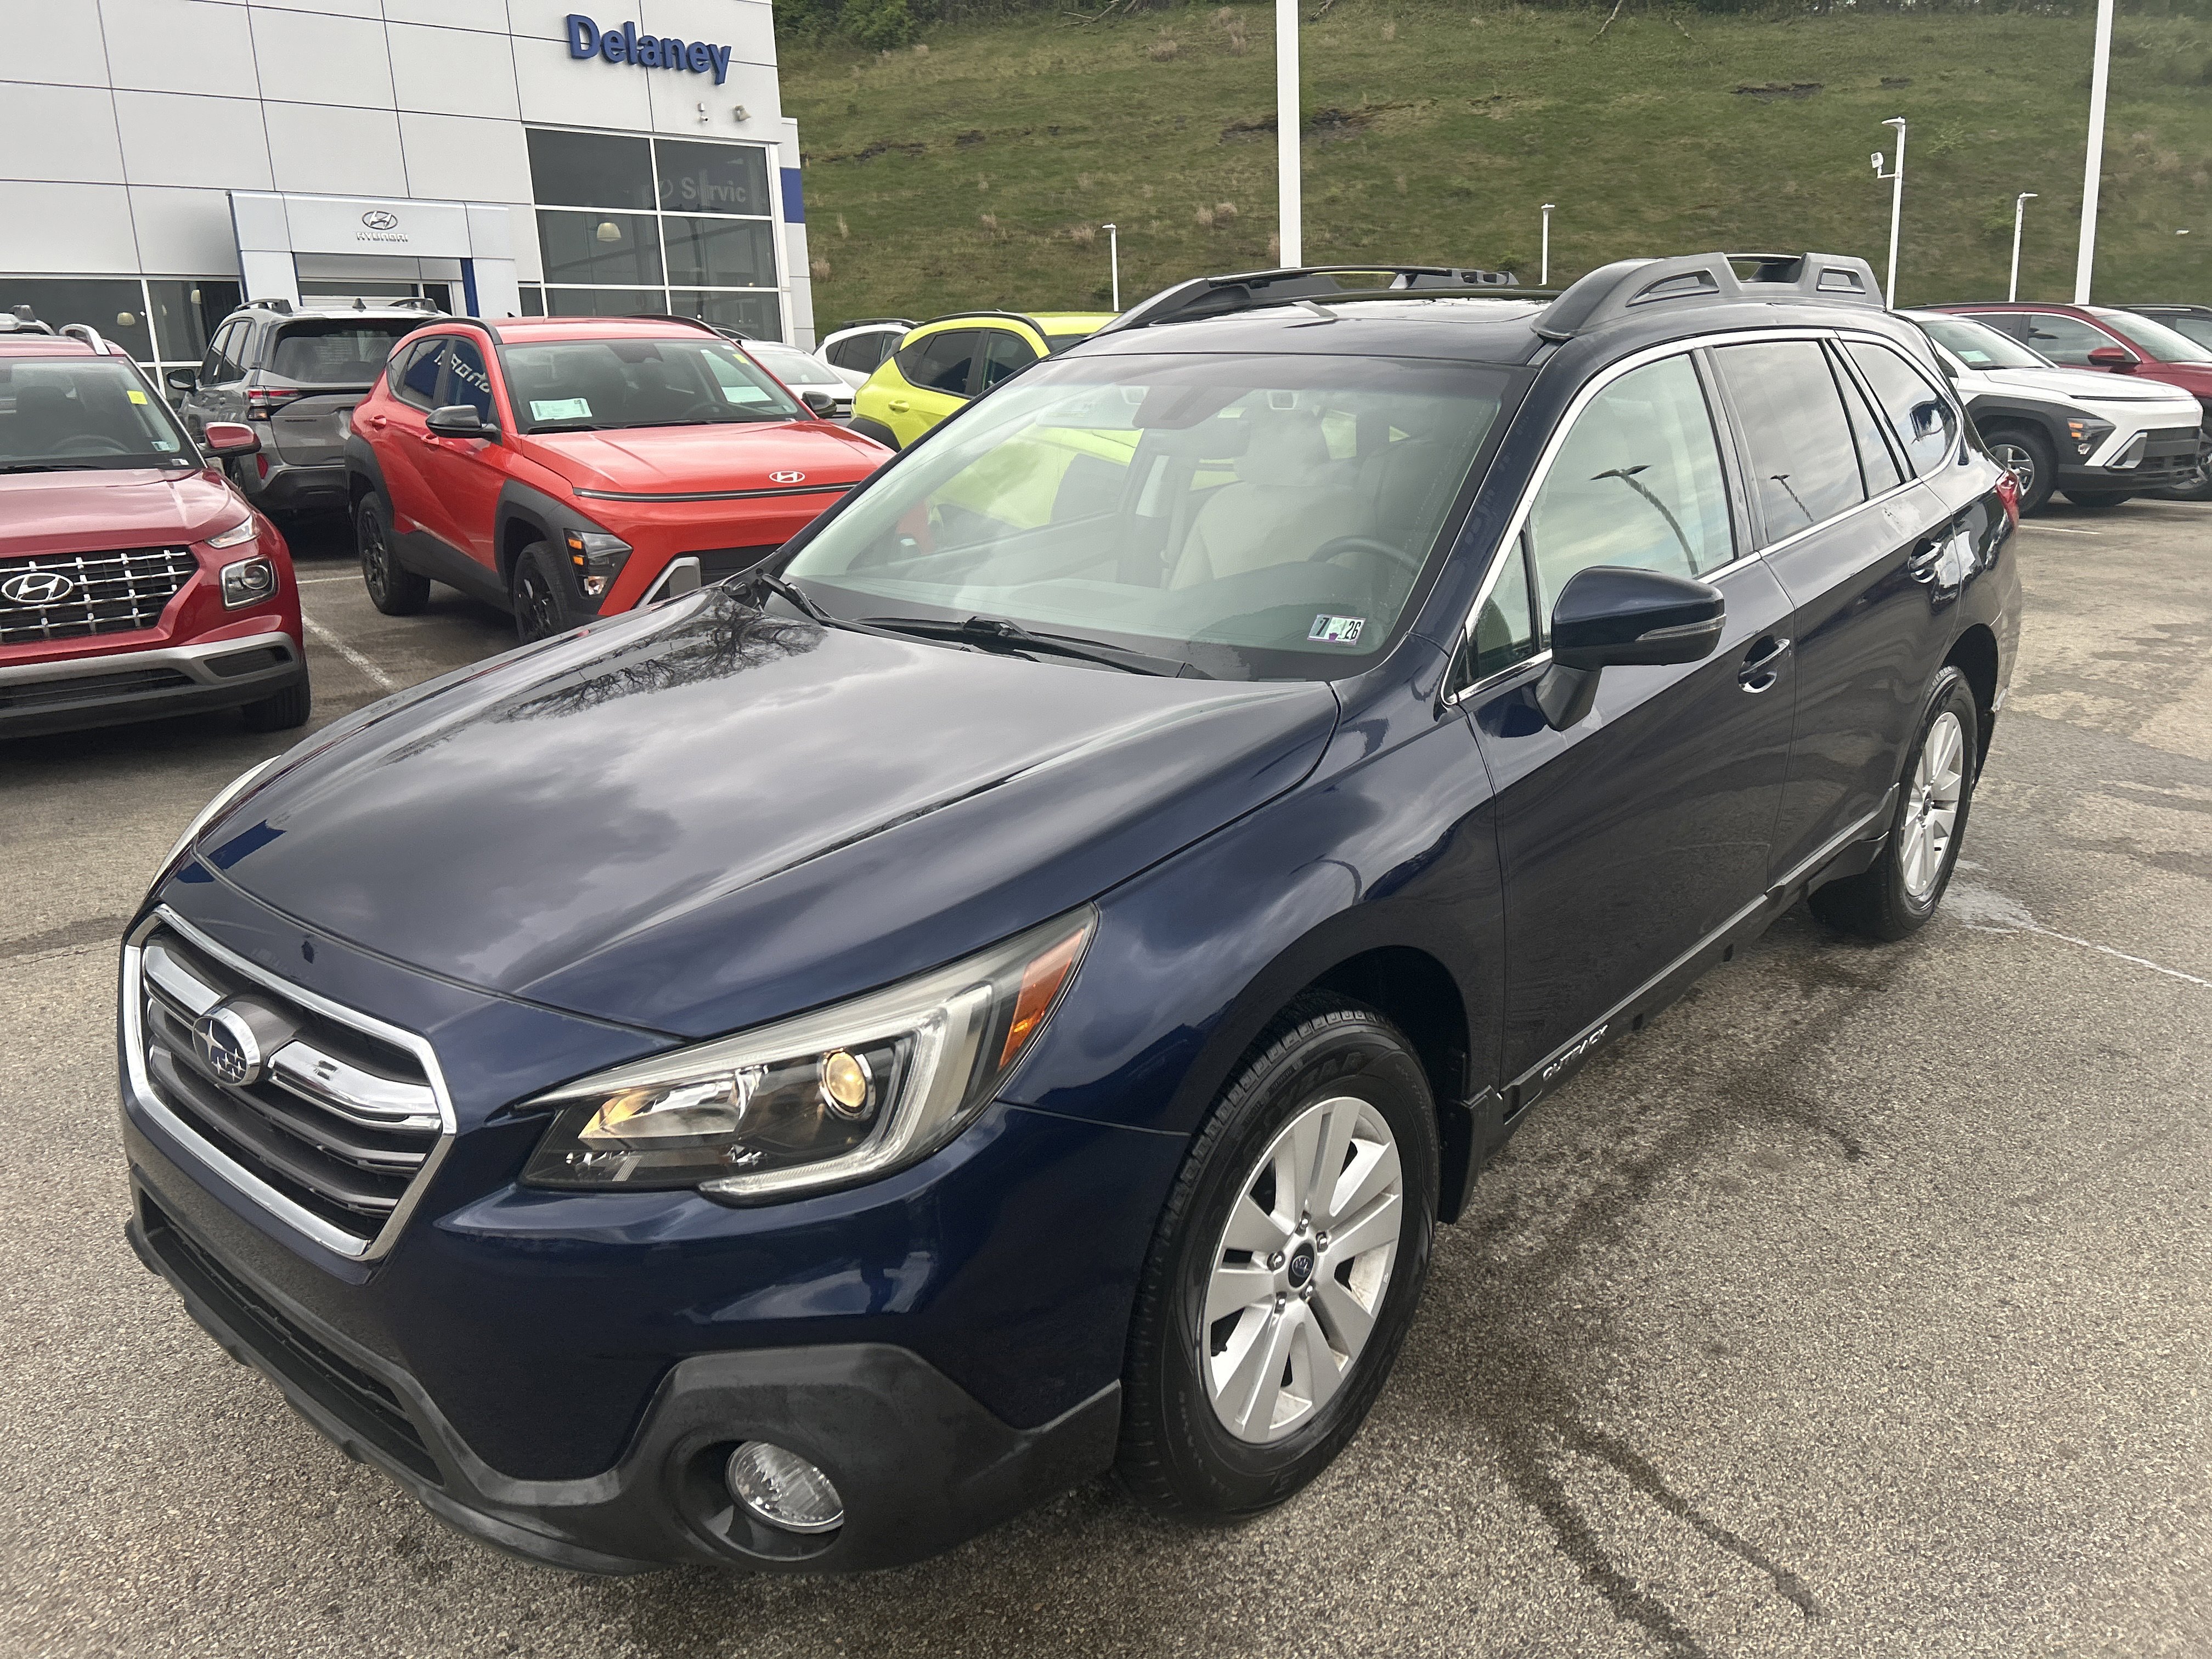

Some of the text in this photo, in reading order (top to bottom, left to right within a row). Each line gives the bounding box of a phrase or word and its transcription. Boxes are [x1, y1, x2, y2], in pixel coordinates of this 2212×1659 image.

[567, 14, 732, 85] Delaney
[357, 232, 408, 242] HYUNDAI
[1316, 617, 1362, 640] 7 26
